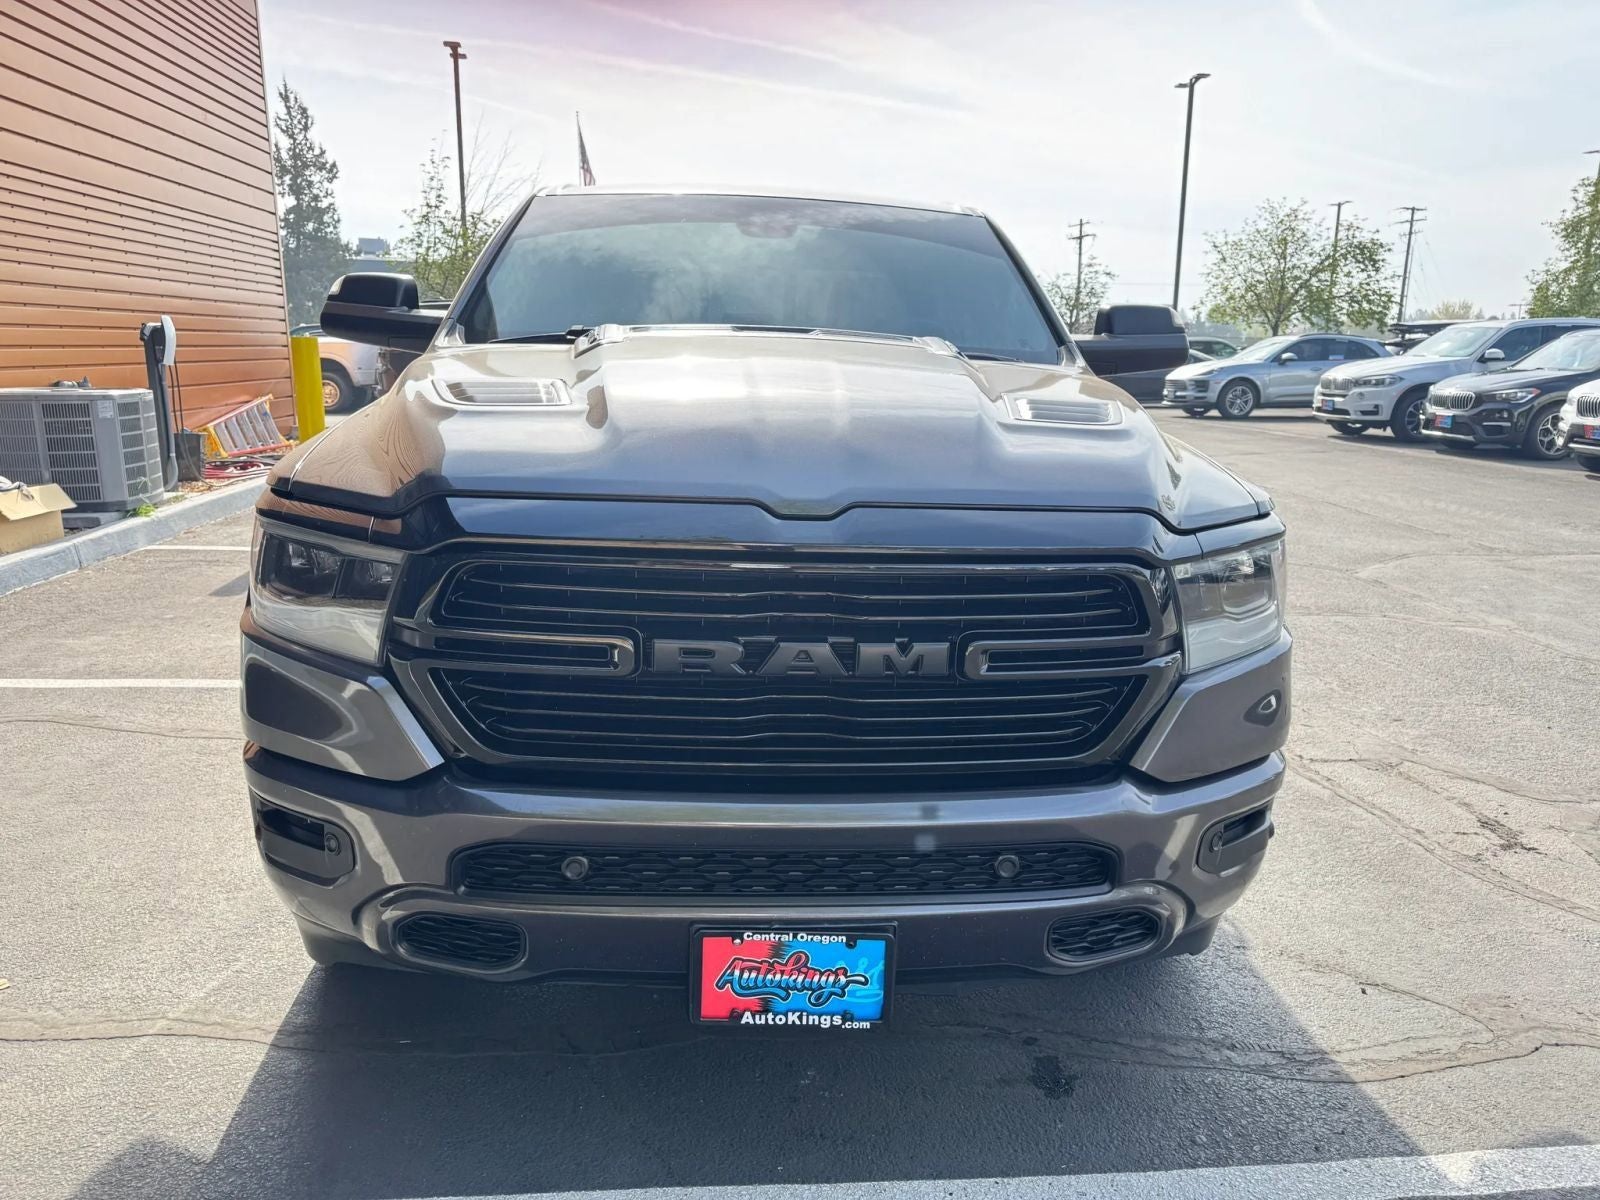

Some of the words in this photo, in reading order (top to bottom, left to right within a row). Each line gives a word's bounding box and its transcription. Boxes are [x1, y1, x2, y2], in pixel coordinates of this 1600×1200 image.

[652, 637, 950, 677] RAM
[742, 931, 794, 942] Central
[796, 933, 847, 944] Oregon
[740, 1011, 871, 1029] AutoKings.com
